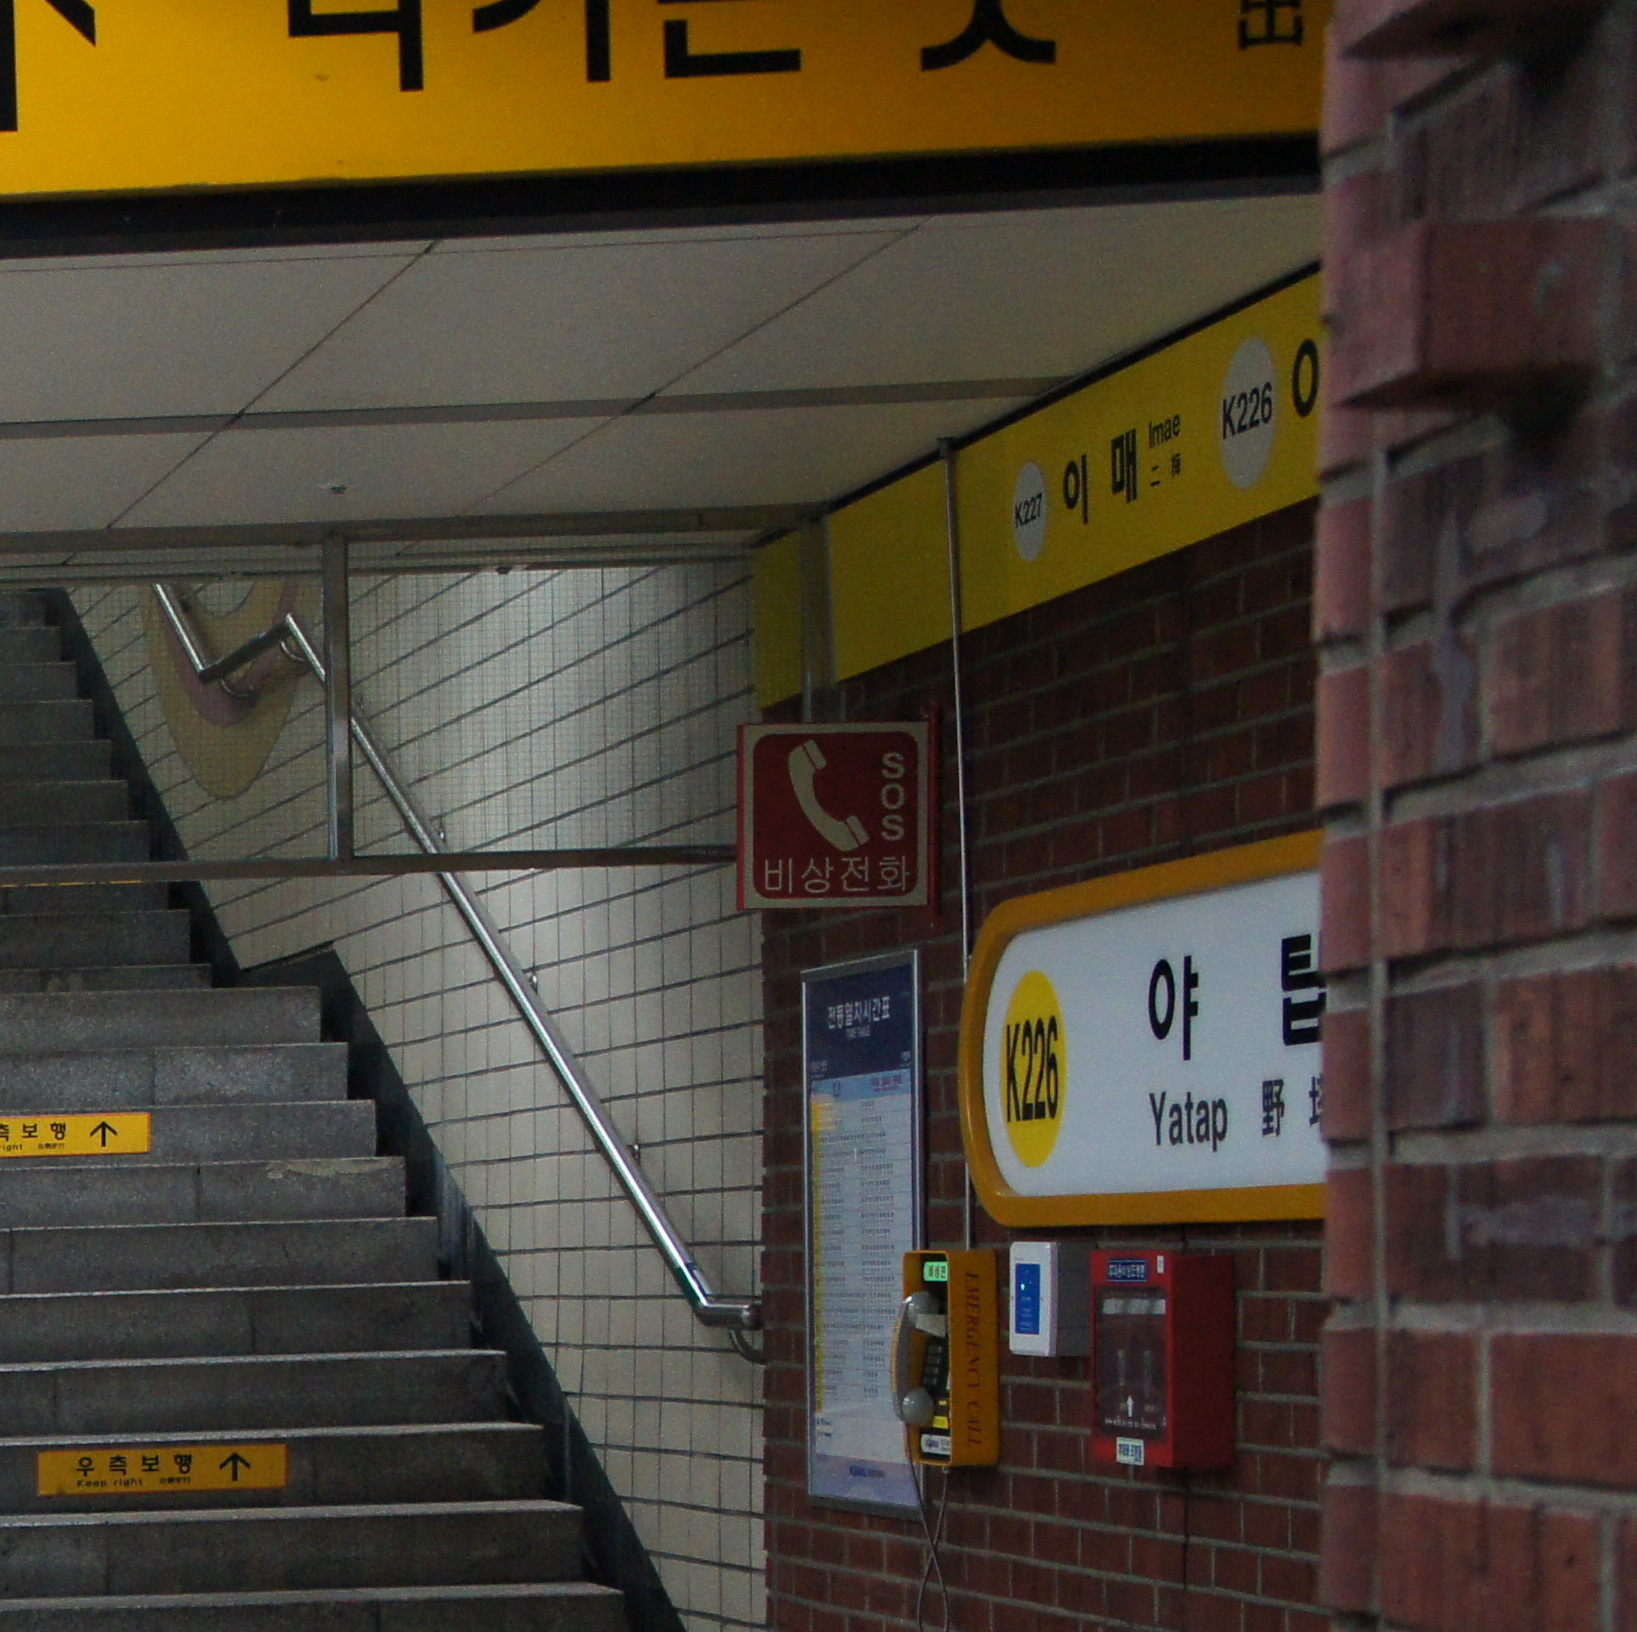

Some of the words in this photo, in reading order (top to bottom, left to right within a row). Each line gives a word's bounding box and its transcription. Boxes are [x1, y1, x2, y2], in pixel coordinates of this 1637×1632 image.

[1147, 412, 1182, 450] Imae
[1221, 381, 1274, 440] K226
[1062, 427, 1139, 526] 이매
[1013, 491, 1044, 529] K227
[880, 751, 906, 842] SOS
[763, 855, 912, 894] 비상전화
[1005, 1014, 1060, 1123] K226
[1148, 1090, 1229, 1153] Yatap
[76, 1453, 194, 1477] 우측보행
[76, 1479, 108, 1488] Keep
[113, 1478, 144, 1487] right
